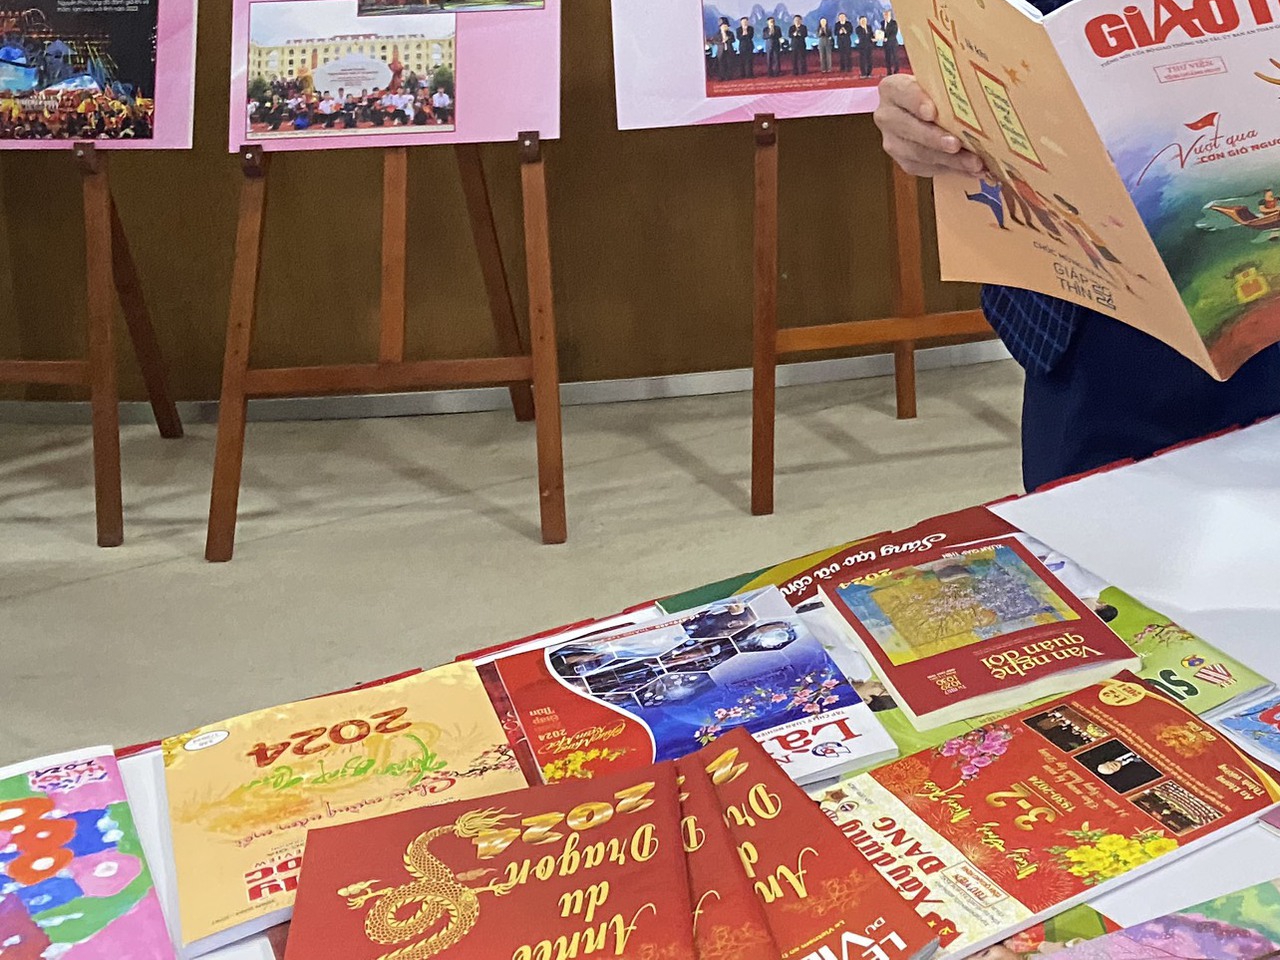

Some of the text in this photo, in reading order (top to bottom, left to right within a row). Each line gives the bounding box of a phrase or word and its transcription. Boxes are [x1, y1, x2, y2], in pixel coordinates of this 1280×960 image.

[1226, 129, 1259, 146] qua
[813, 533, 947, 579] Sáng tạo và
[838, 568, 892, 590] 2024
[246, 707, 412, 769] 2024
[538, 729, 567, 741] 2024
[474, 781, 655, 860] 2024
[504, 823, 658, 884] Dragon
[558, 881, 610, 923] du
[800, 927, 835, 949] Vietnam
[865, 916, 886, 935] DU
